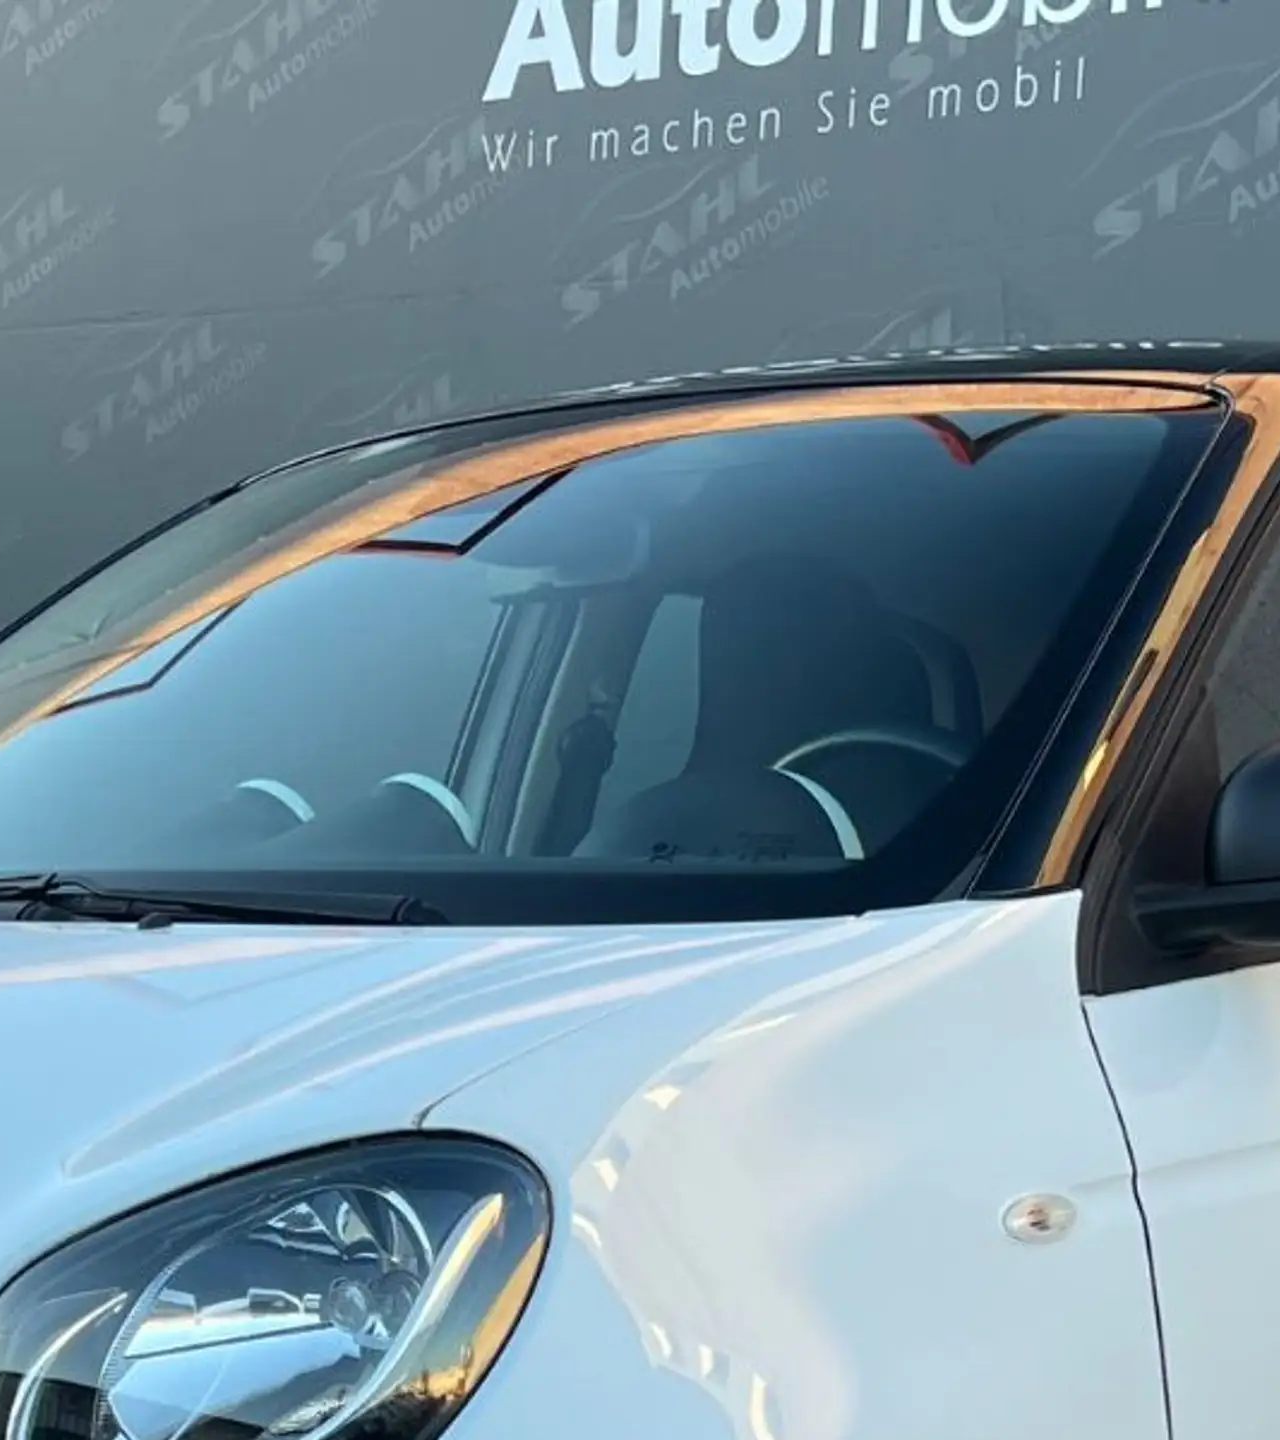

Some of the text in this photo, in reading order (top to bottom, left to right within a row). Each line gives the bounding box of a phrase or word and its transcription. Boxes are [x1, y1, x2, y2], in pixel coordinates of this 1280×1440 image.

[480, 129, 560, 173] Wir
[590, 108, 782, 162] machen
[817, 86, 891, 134] Sie
[928, 56, 1087, 119] mobil
[2, 203, 118, 309] Automobile
[561, 153, 776, 332] STAHL
[670, 174, 830, 301] Automobile
[60, 320, 226, 463] STAHL
[145, 340, 268, 446] Automobile
